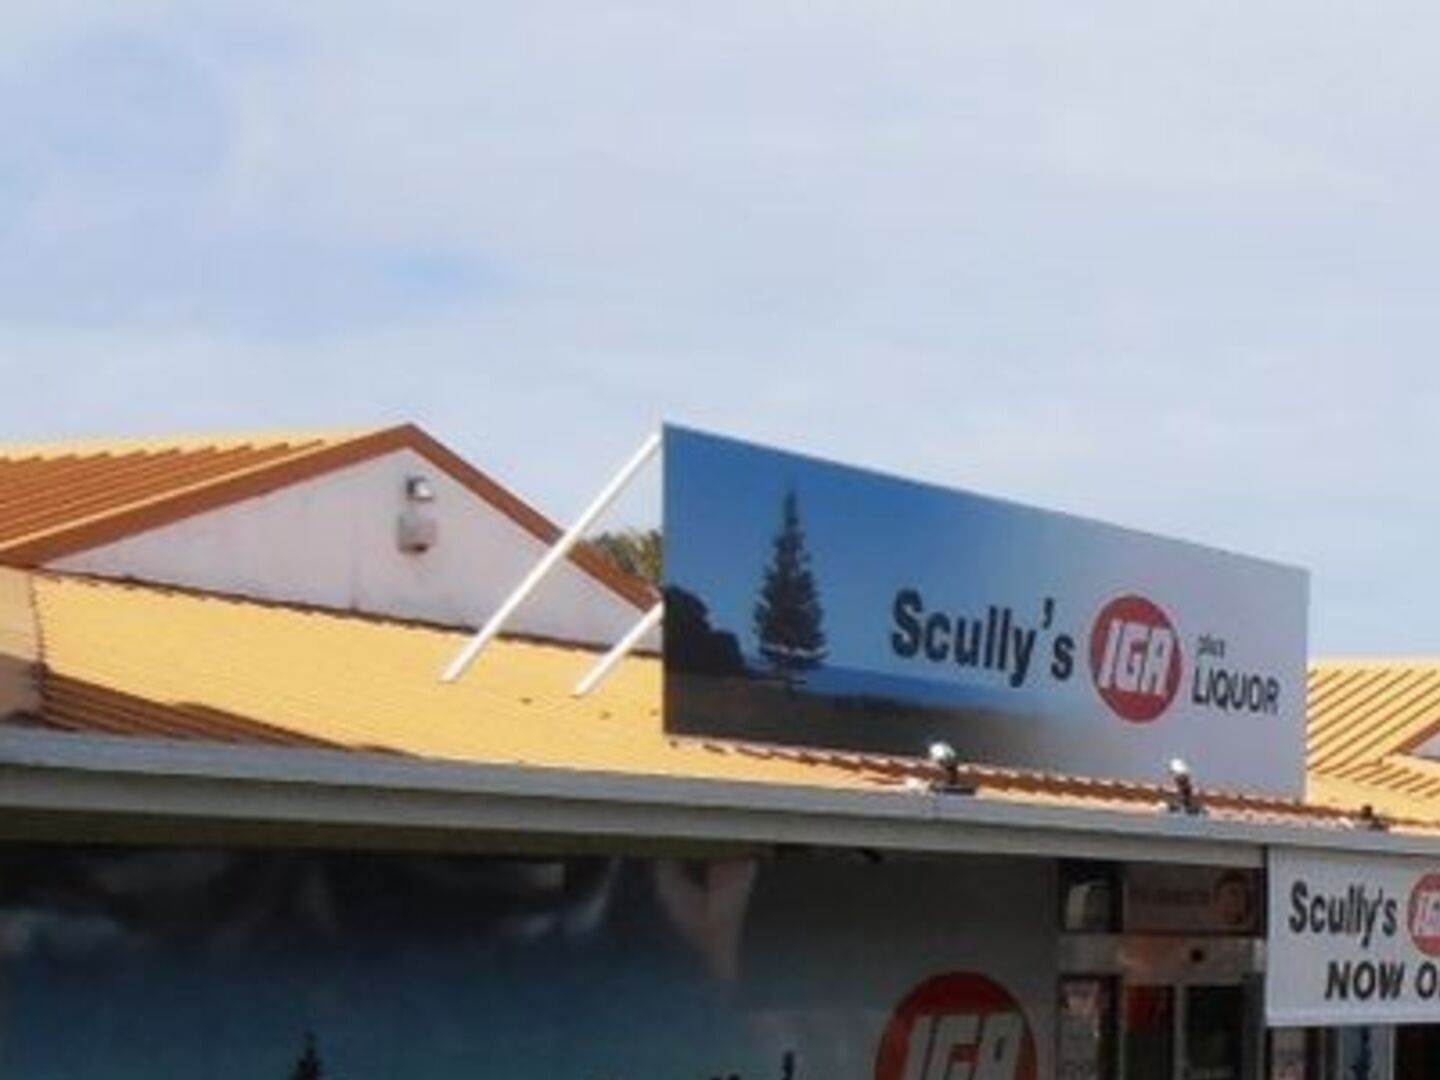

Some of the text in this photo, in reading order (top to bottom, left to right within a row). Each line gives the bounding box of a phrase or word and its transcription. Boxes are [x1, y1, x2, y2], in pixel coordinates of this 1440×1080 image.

[890, 590, 1173, 697] Scully's IGA
[1192, 666, 1280, 717] LIQUOR
[1289, 879, 1398, 948] Scully's
[1325, 962, 1405, 1000] NOW
